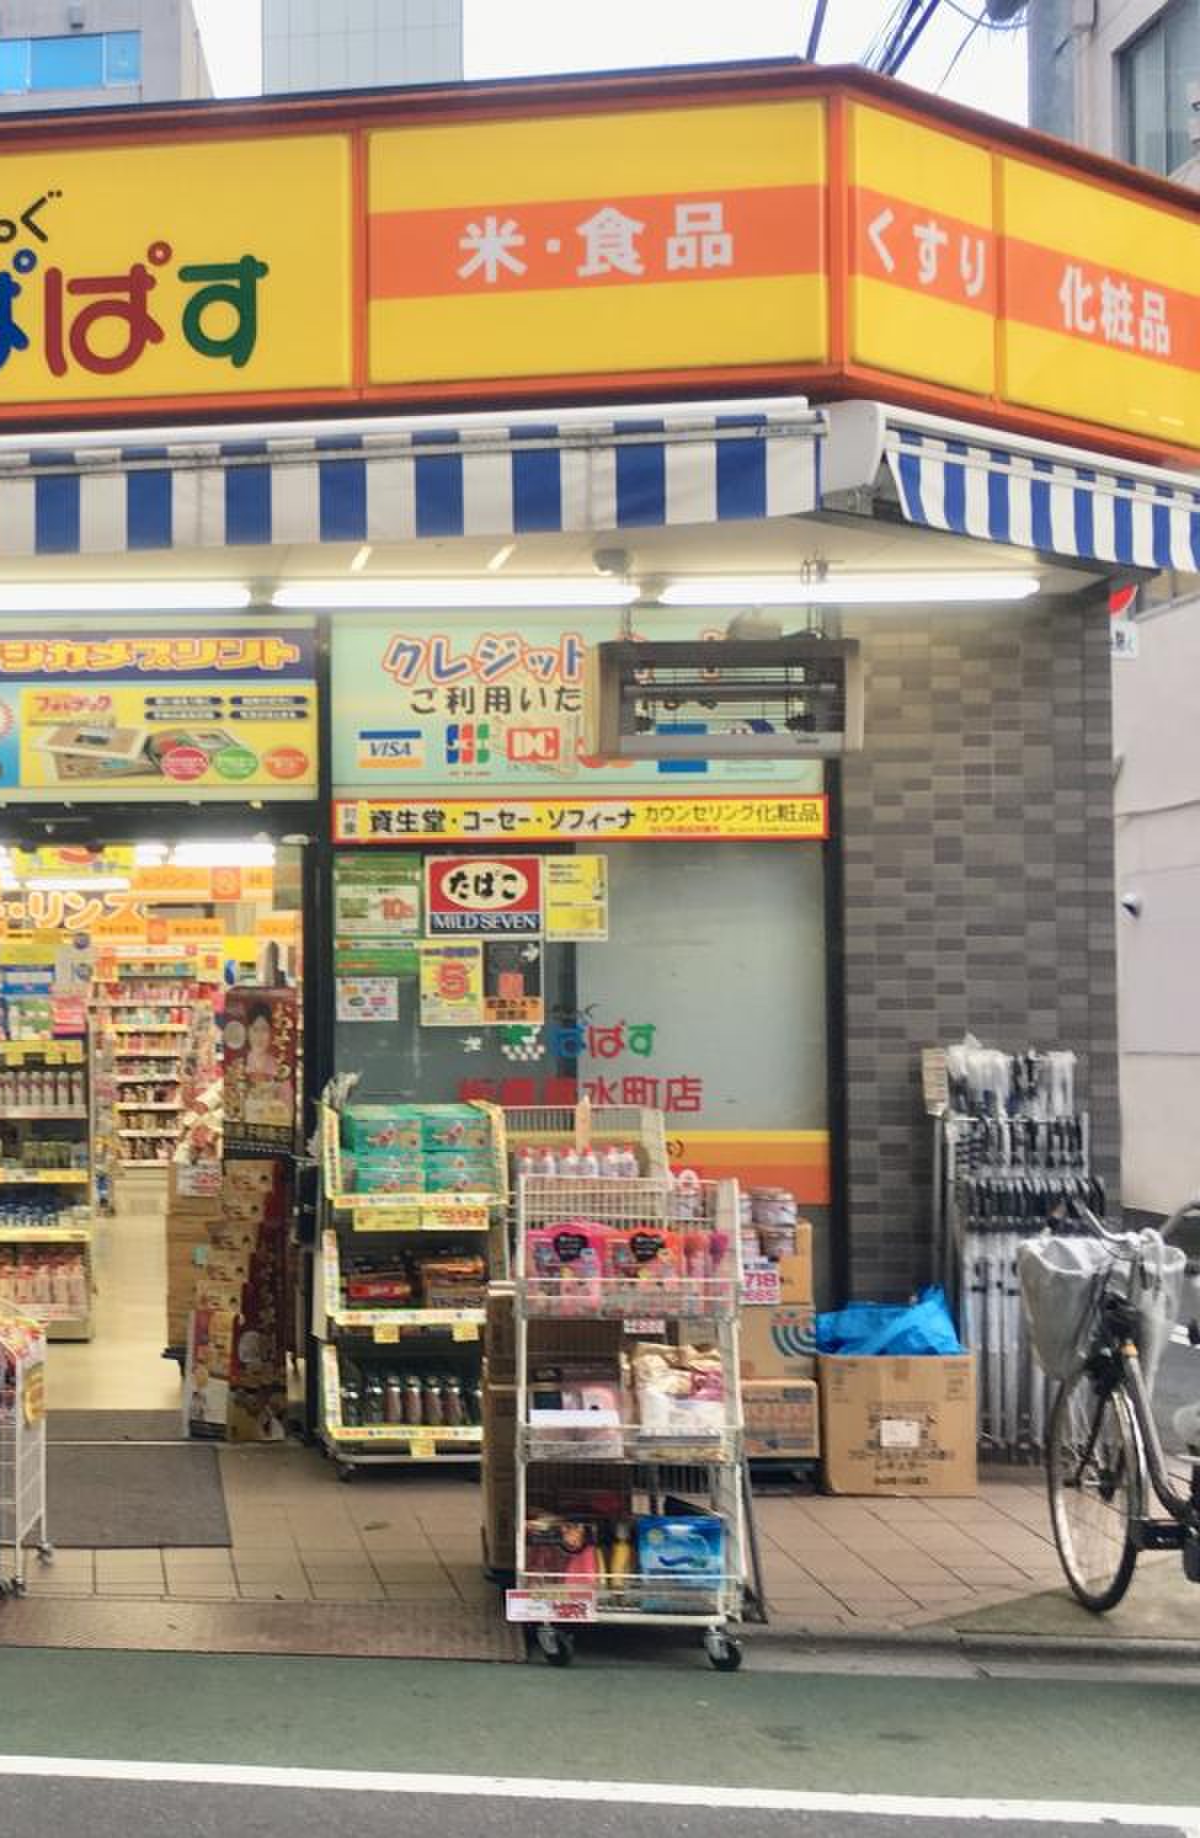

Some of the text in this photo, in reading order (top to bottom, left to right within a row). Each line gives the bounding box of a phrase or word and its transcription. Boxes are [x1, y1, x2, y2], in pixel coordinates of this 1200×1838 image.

[455, 198, 734, 284] 米・食品
[865, 208, 988, 298] くすり
[1058, 264, 1171, 356] 化粧品
[384, 633, 588, 686] クレジット
[368, 740, 414, 757] VISA
[369, 808, 636, 833] 資生堂・コーセー・ソフィーナ
[643, 803, 821, 823] カウンセリング化粧品
[448, 870, 519, 901] たばこ
[432, 914, 537, 929] MILD SEVEN
